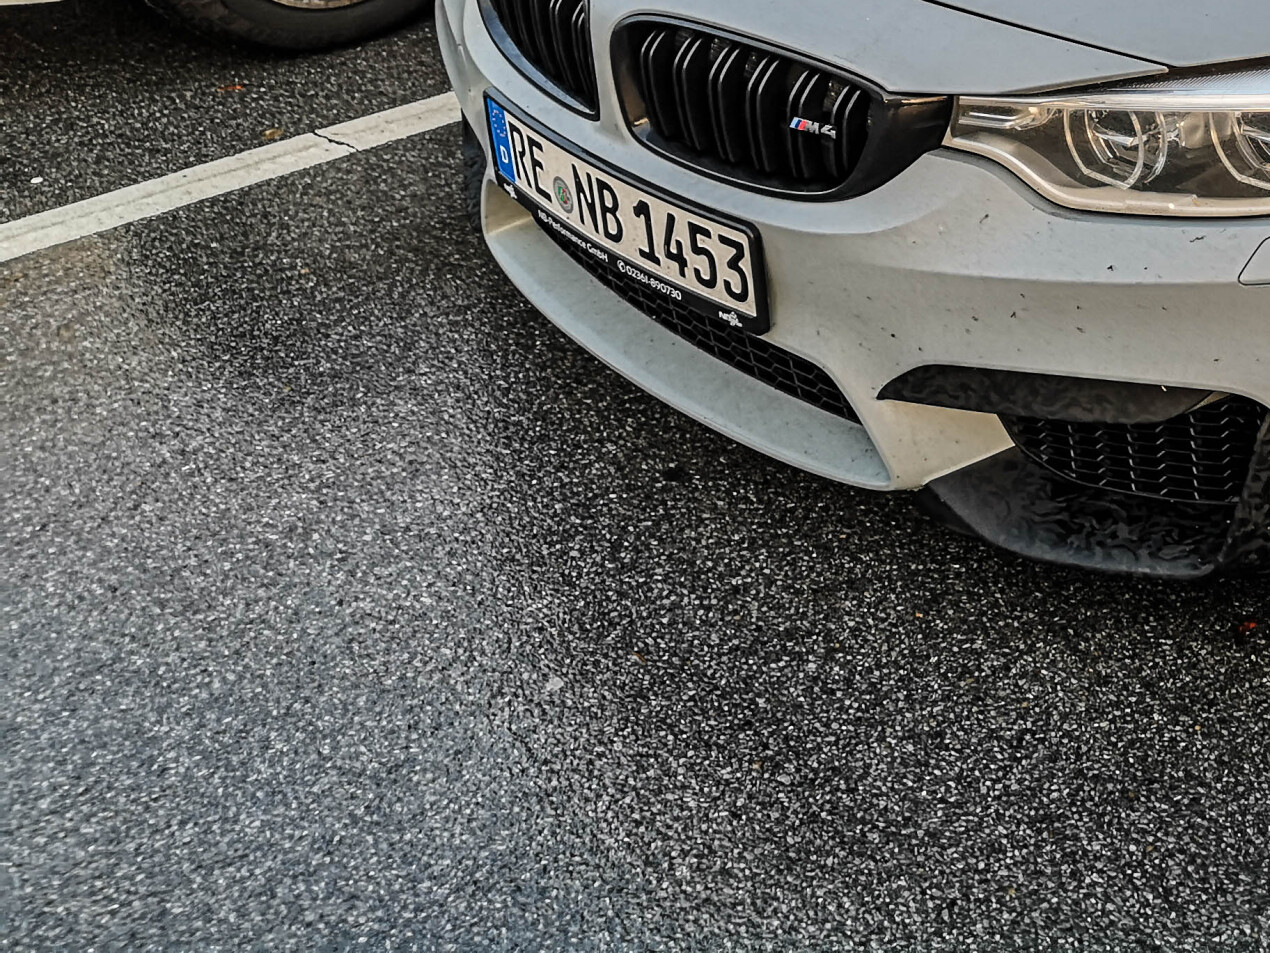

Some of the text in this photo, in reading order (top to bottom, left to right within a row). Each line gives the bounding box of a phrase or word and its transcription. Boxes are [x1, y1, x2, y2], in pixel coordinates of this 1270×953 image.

[804, 120, 836, 139] M4
[500, 144, 509, 164] D
[508, 120, 749, 303] RE NB 1453
